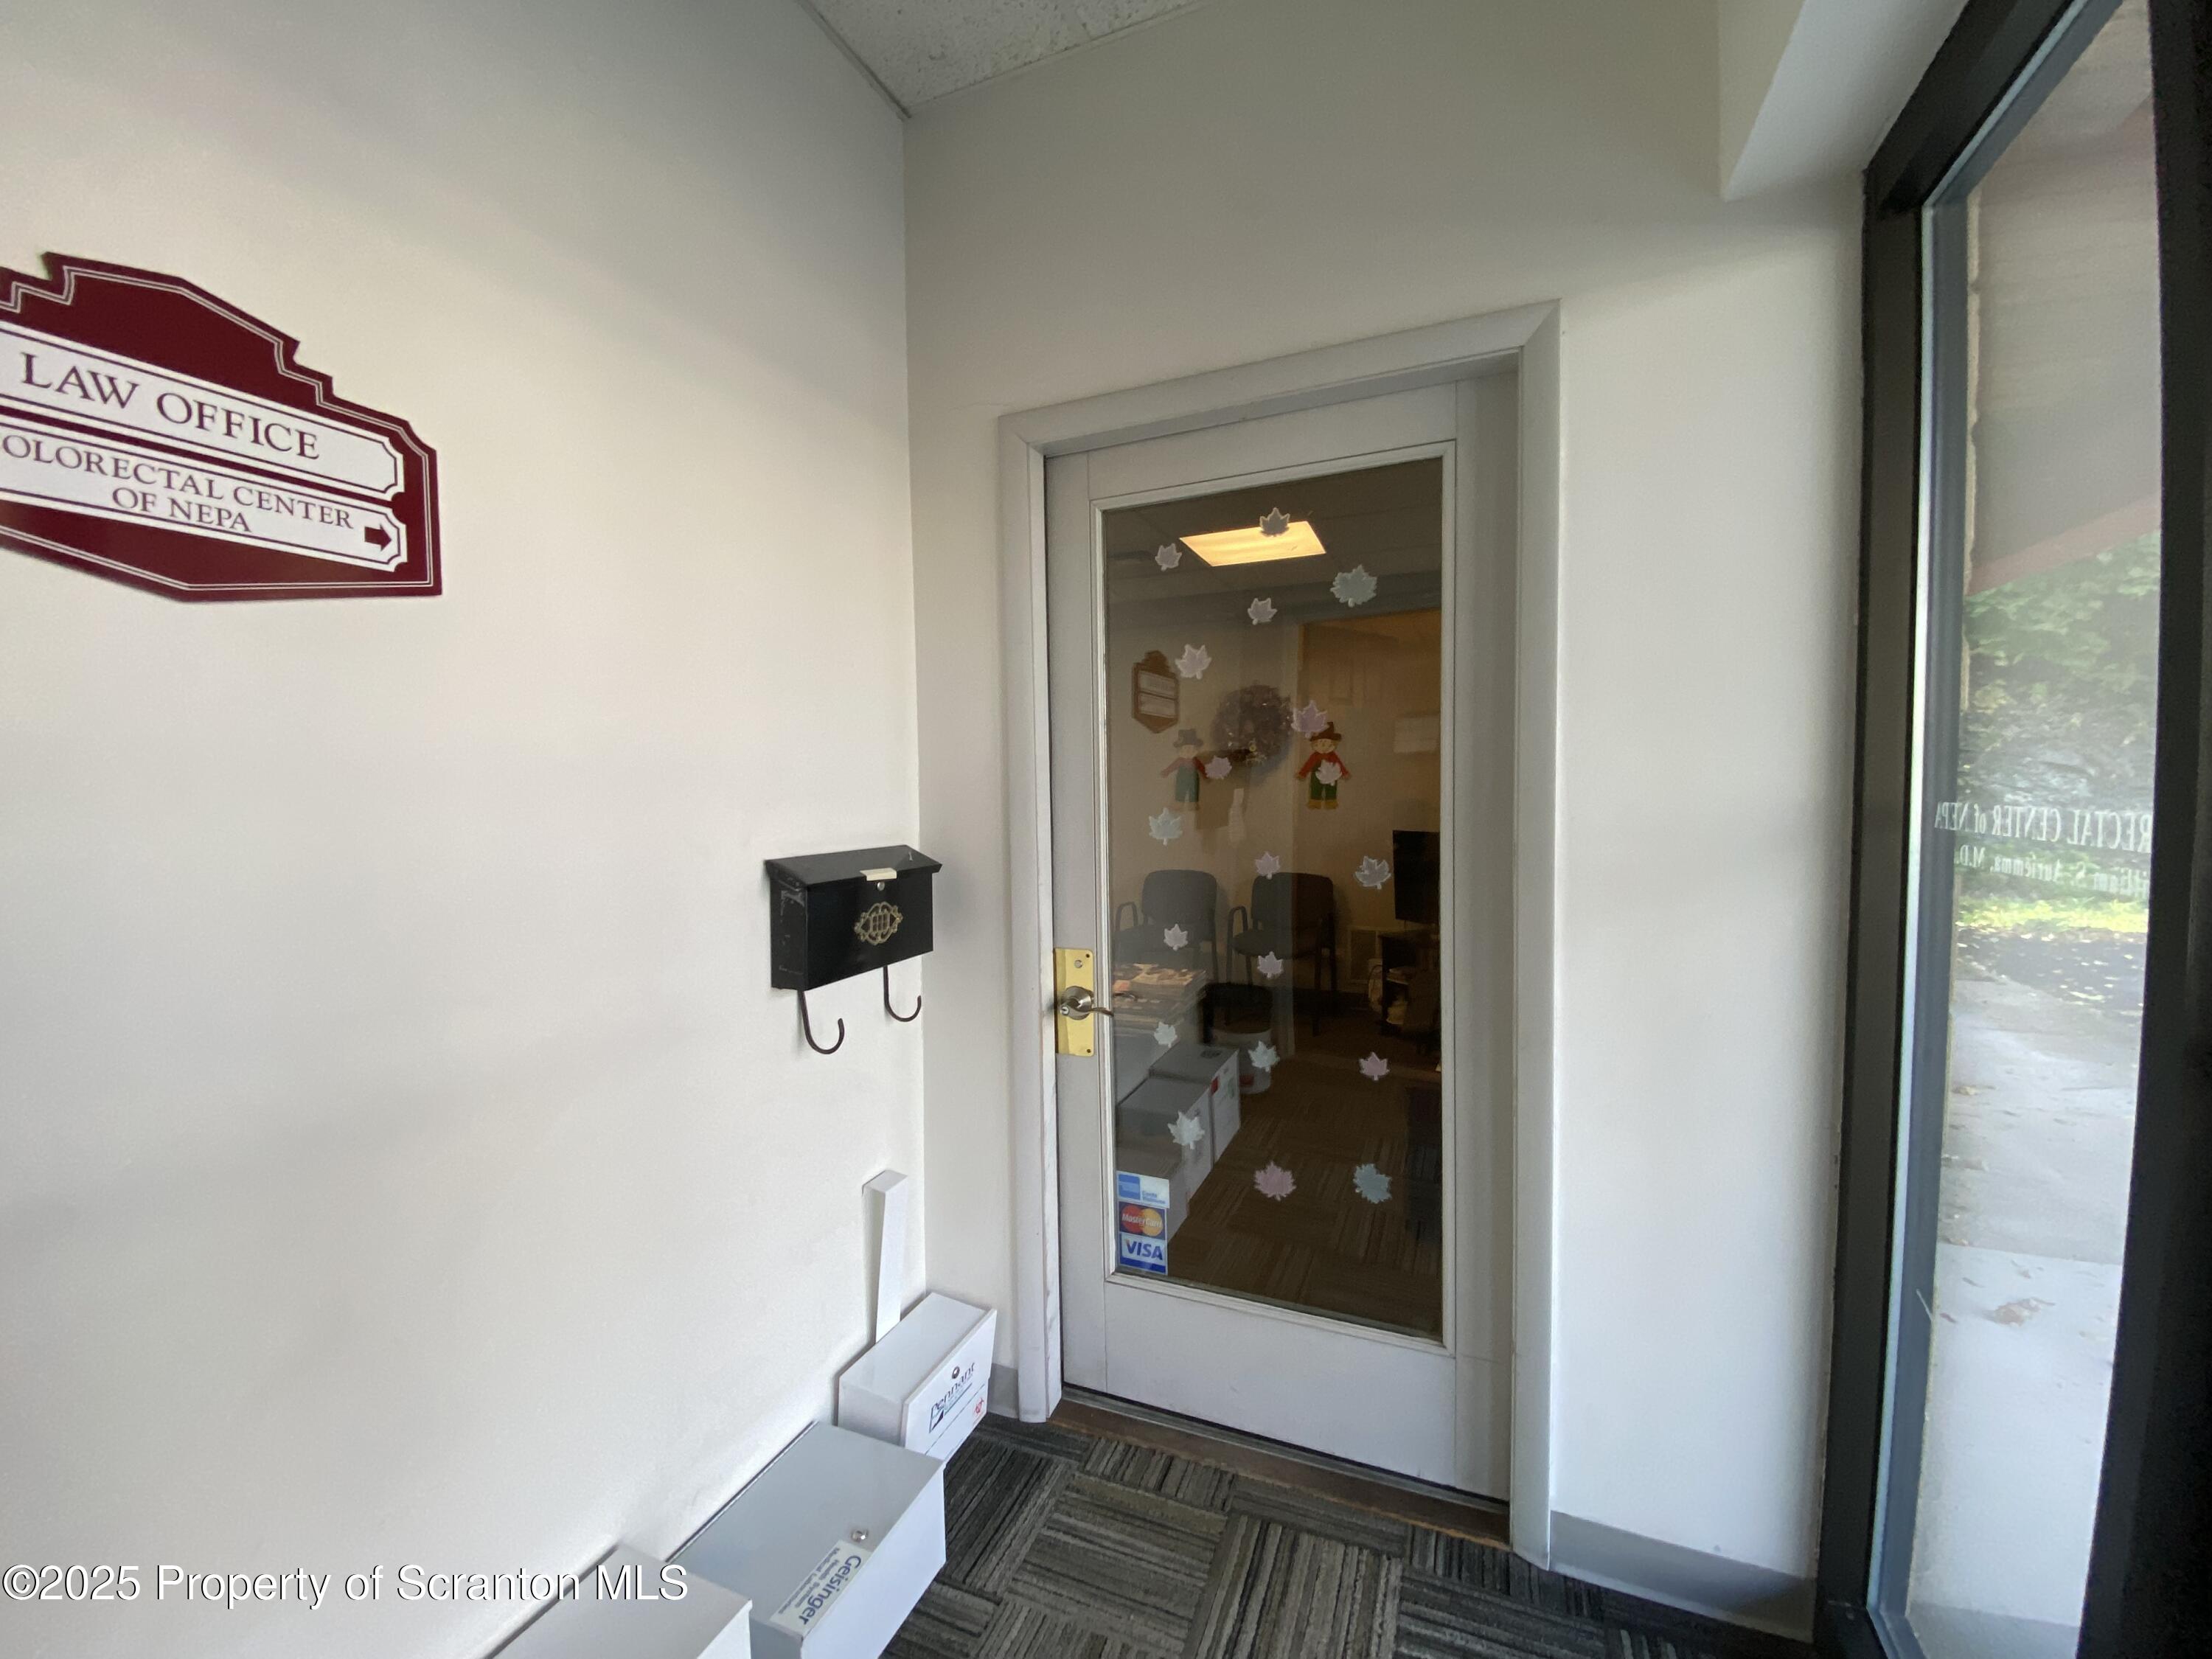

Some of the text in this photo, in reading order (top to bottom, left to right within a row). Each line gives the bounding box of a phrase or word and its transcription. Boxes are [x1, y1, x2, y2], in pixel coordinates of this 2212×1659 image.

[21, 352, 320, 460] LAW OFFICE
[113, 487, 252, 532] OF NEPA
[233, 485, 354, 529] CENTER
[1121, 1214, 1163, 1229] MasterCard
[1125, 1239, 1163, 1261] VISA
[799, 1554, 862, 1625] Geisinger
